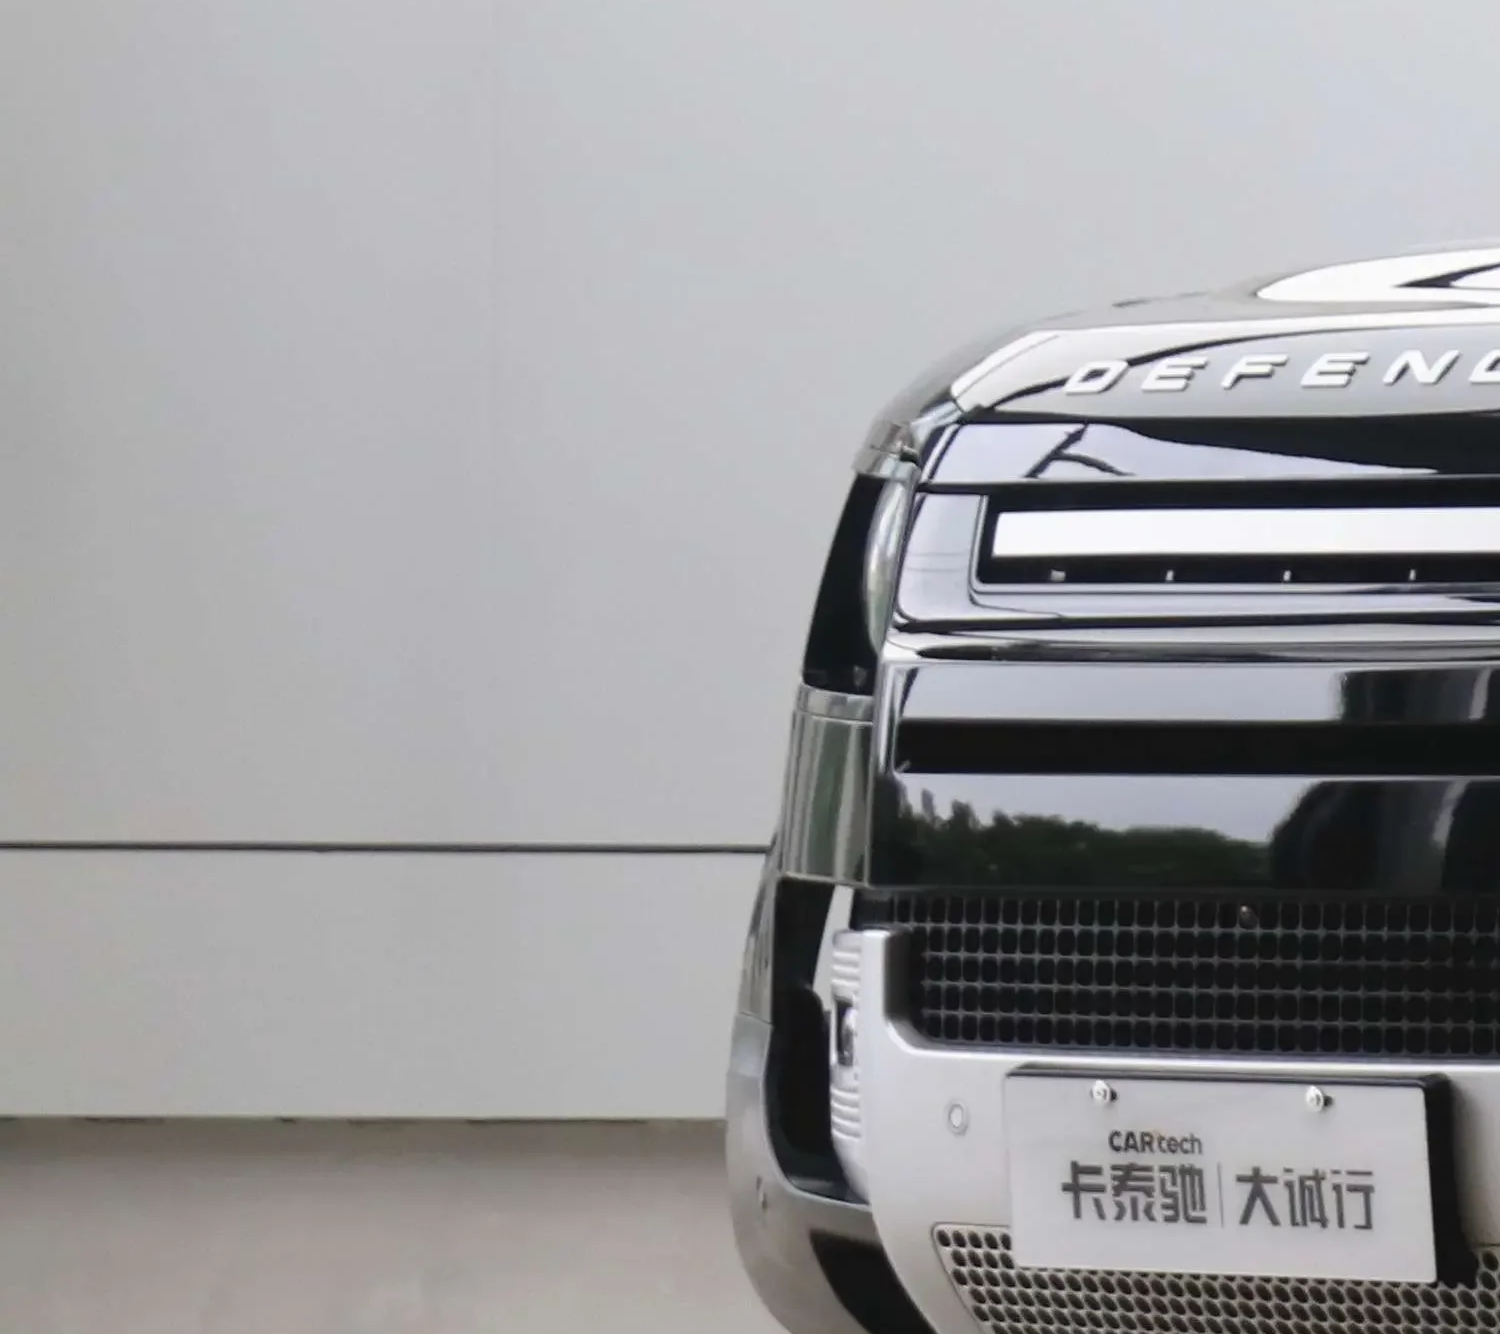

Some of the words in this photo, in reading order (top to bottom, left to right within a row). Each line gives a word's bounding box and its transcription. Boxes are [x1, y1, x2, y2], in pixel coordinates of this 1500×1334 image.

[1108, 1130, 1203, 1155] CARtech
[1061, 1161, 1207, 1223] 卡泰驰
[1236, 1167, 1375, 1230] 大诚行
